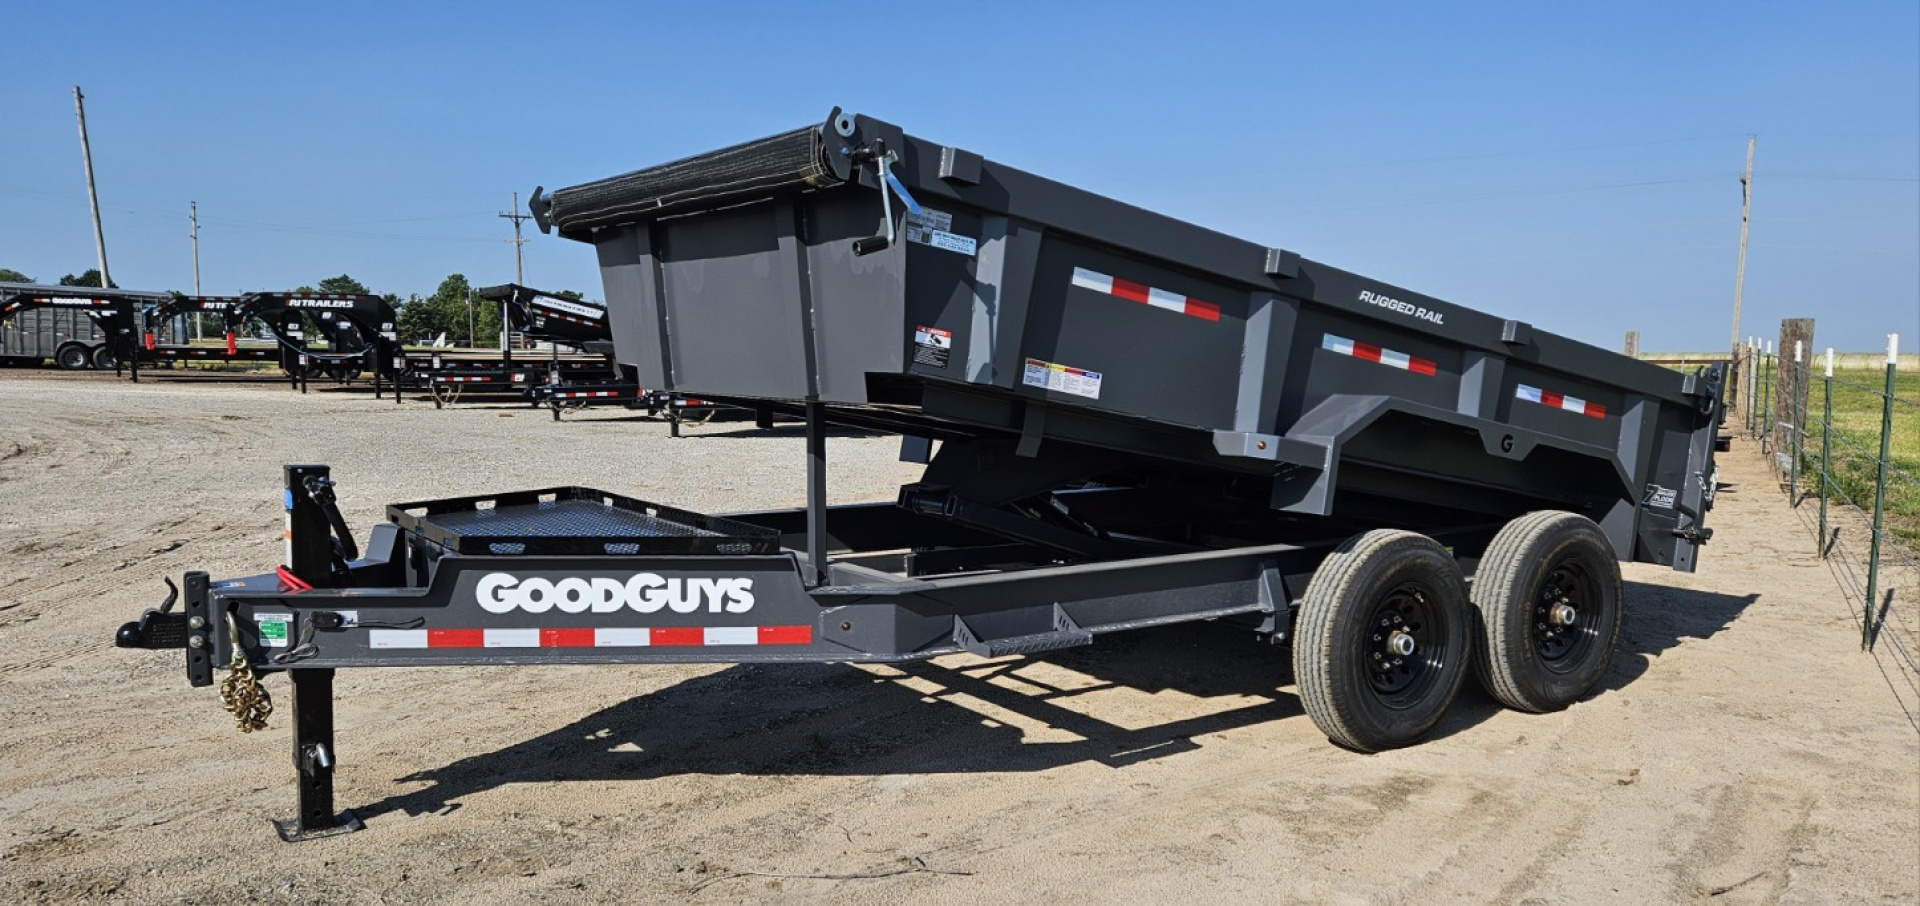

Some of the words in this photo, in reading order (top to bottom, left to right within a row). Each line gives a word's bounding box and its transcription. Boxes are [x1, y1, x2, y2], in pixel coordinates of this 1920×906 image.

[302, 299, 354, 308] TRAILERS
[1359, 290, 1415, 316] RUGGED
[1415, 307, 1444, 325] RAIL
[1501, 433, 1514, 454] G
[475, 572, 755, 614] GOODGUYS
